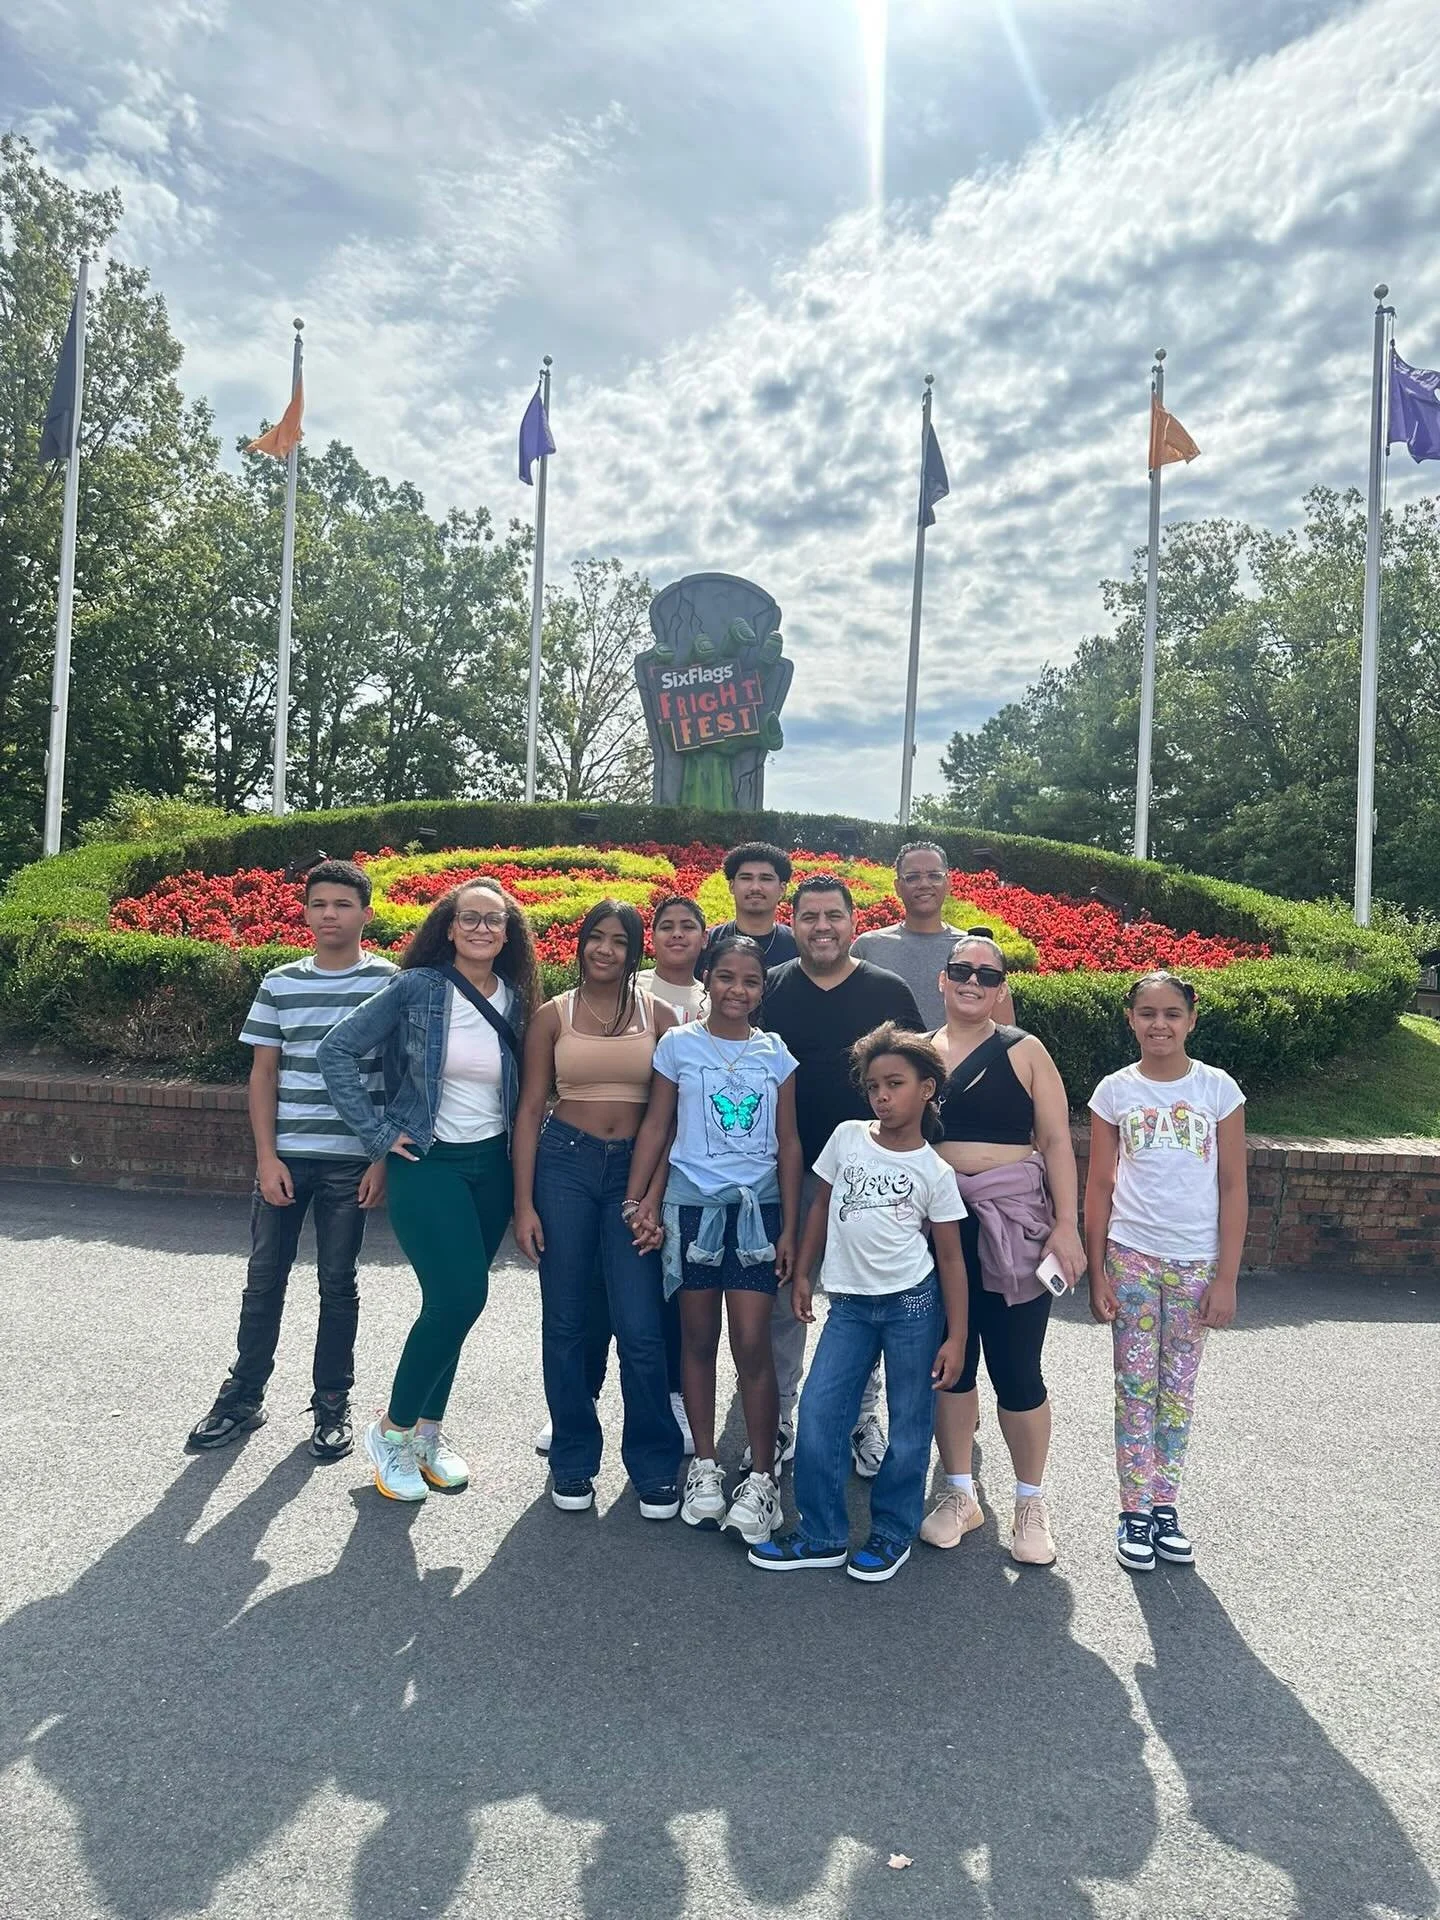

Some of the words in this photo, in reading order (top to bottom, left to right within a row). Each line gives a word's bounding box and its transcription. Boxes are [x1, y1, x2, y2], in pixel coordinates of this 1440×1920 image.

[659, 680, 756, 719] FRIGHT
[680, 708, 751, 745] FEST
[1126, 1106, 1209, 1155] GAP
